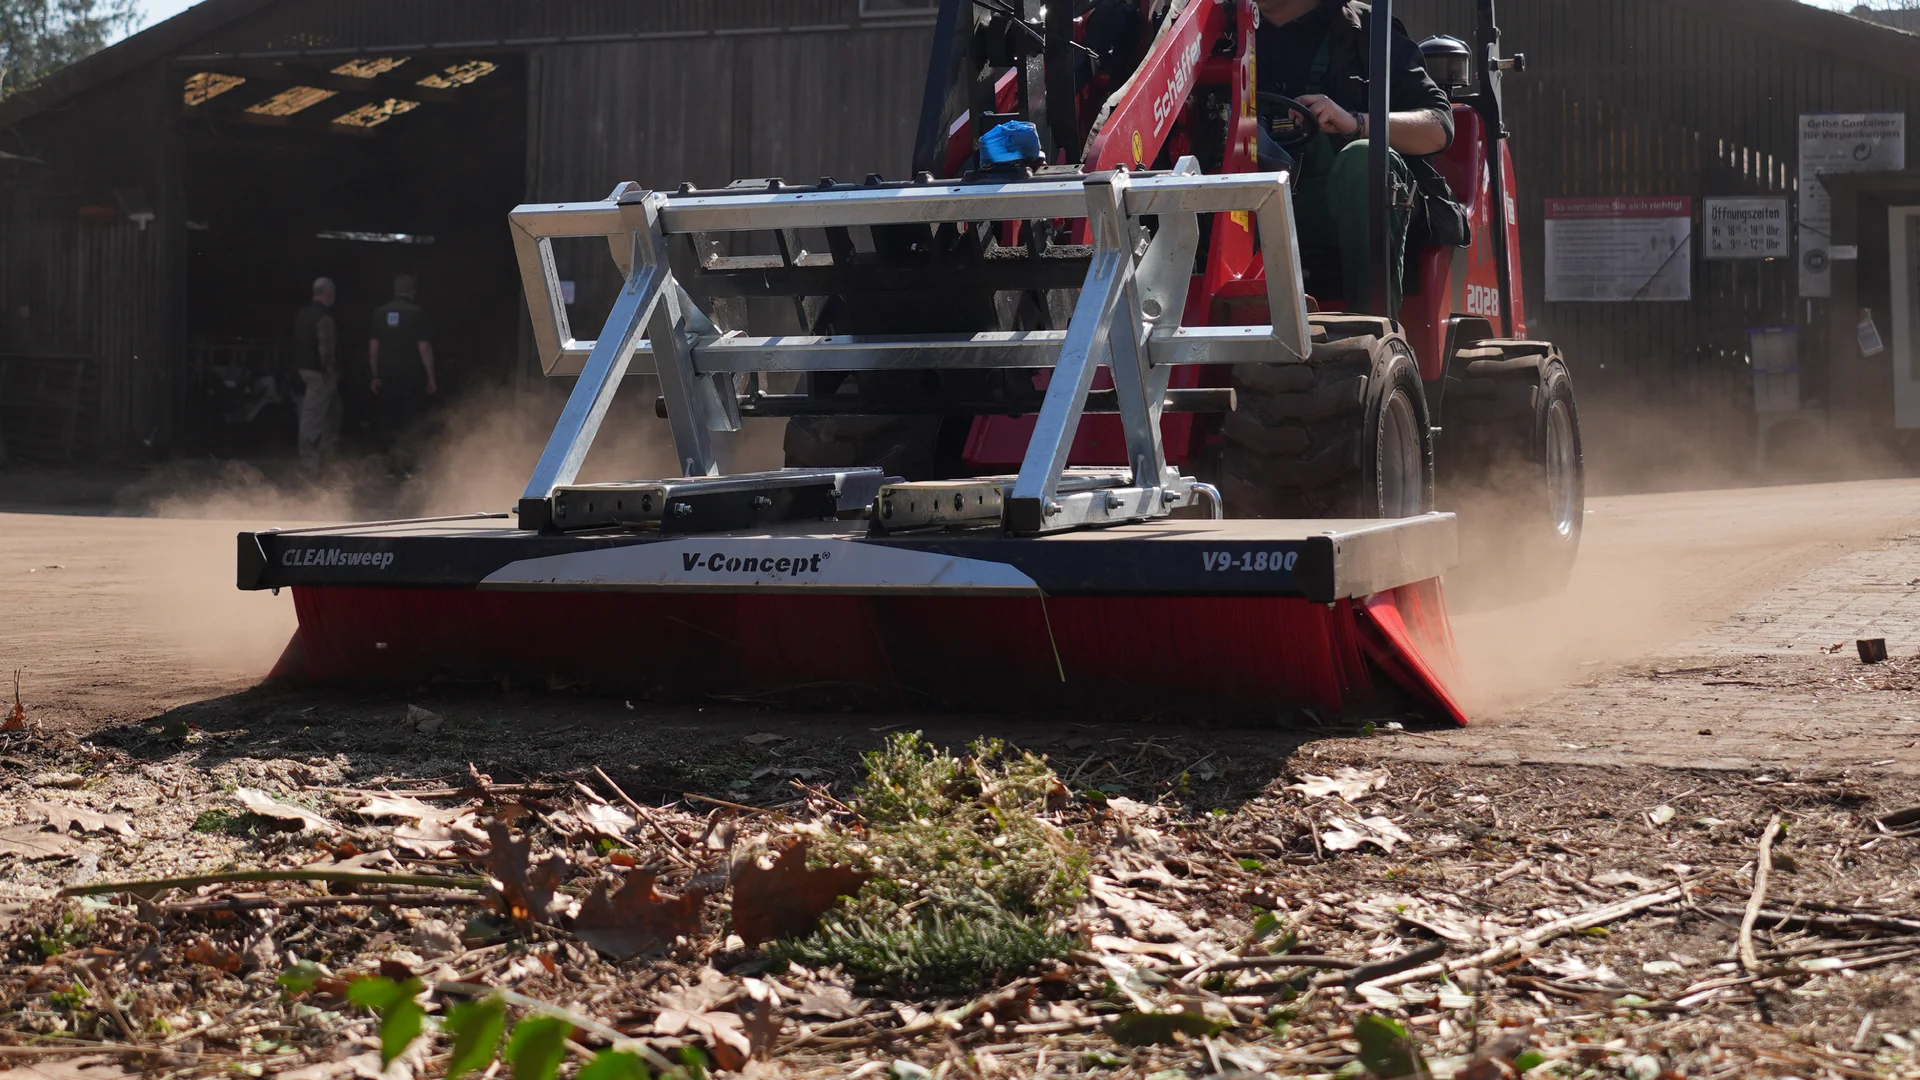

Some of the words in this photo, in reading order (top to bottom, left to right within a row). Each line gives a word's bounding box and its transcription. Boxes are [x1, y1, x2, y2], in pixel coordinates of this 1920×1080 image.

[1153, 31, 1203, 138] Schäffer
[1841, 118, 1897, 128] Container
[1803, 130, 1818, 140] für
[1821, 129, 1900, 140] Verpackungen
[1552, 202, 1565, 212] So
[1611, 200, 1627, 211] Sie
[1628, 200, 1648, 211] sich
[1649, 200, 1683, 212] richtig!
[1711, 204, 1780, 224] Öffnungszeiten
[1711, 225, 1721, 236] Mi
[1766, 224, 1780, 236] Uhr
[1766, 238, 1780, 250] Uhr
[1467, 284, 1499, 317] 2028
[281, 548, 394, 570] CLEANsweep
[1202, 551, 1298, 571] V9-1800
